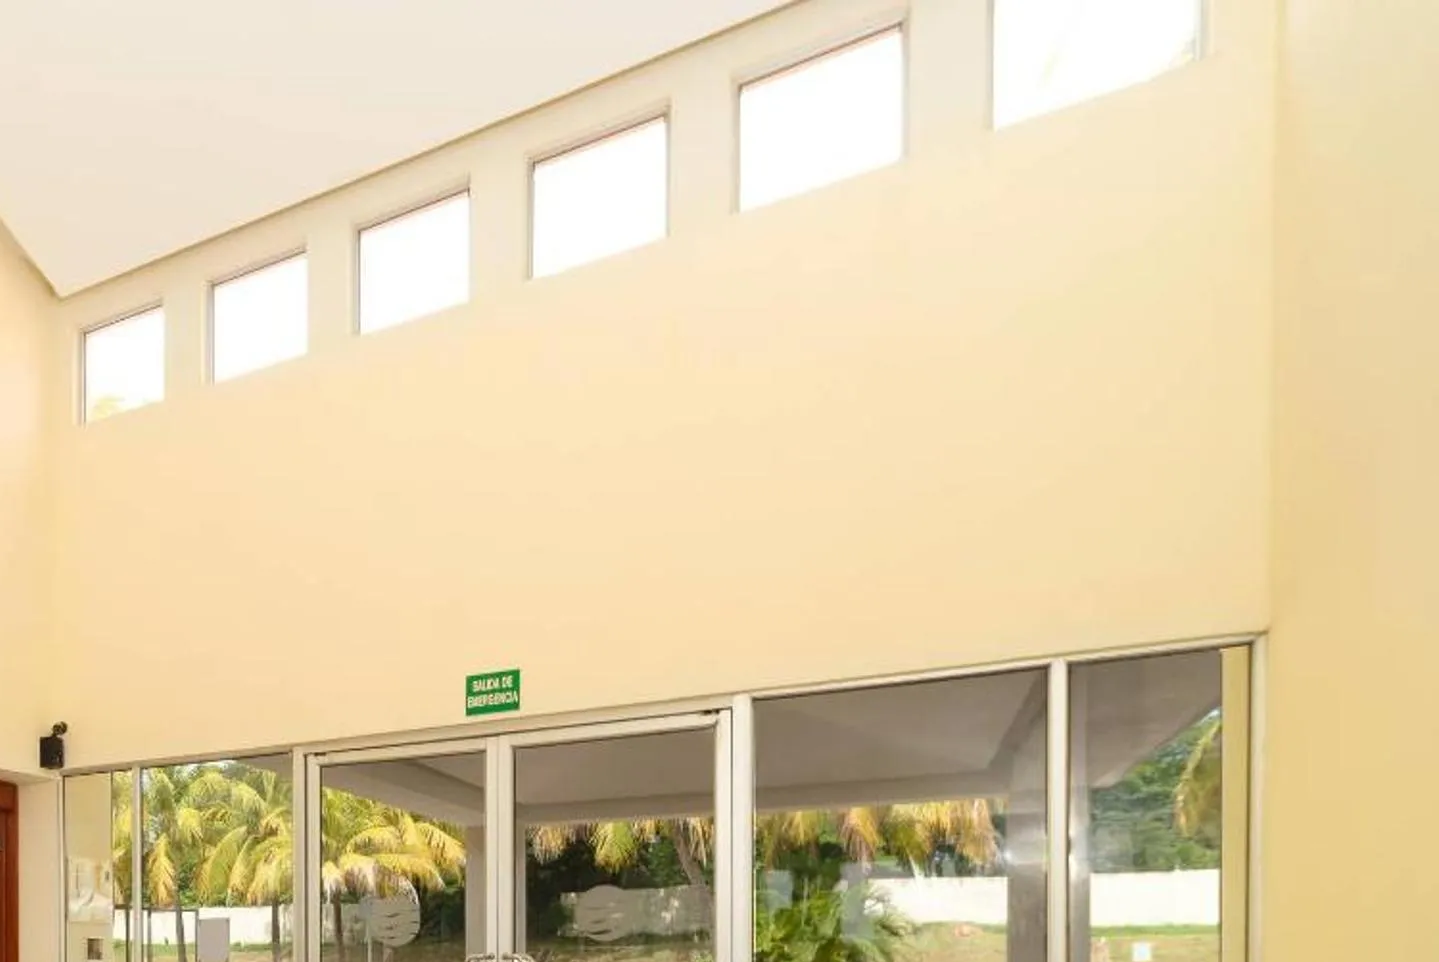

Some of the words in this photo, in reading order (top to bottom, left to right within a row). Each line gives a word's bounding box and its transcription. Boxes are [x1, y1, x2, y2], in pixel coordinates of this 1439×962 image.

[473, 677, 499, 692] SALIDA
[502, 675, 513, 688] DE
[468, 690, 518, 708] EMERGENCIA
